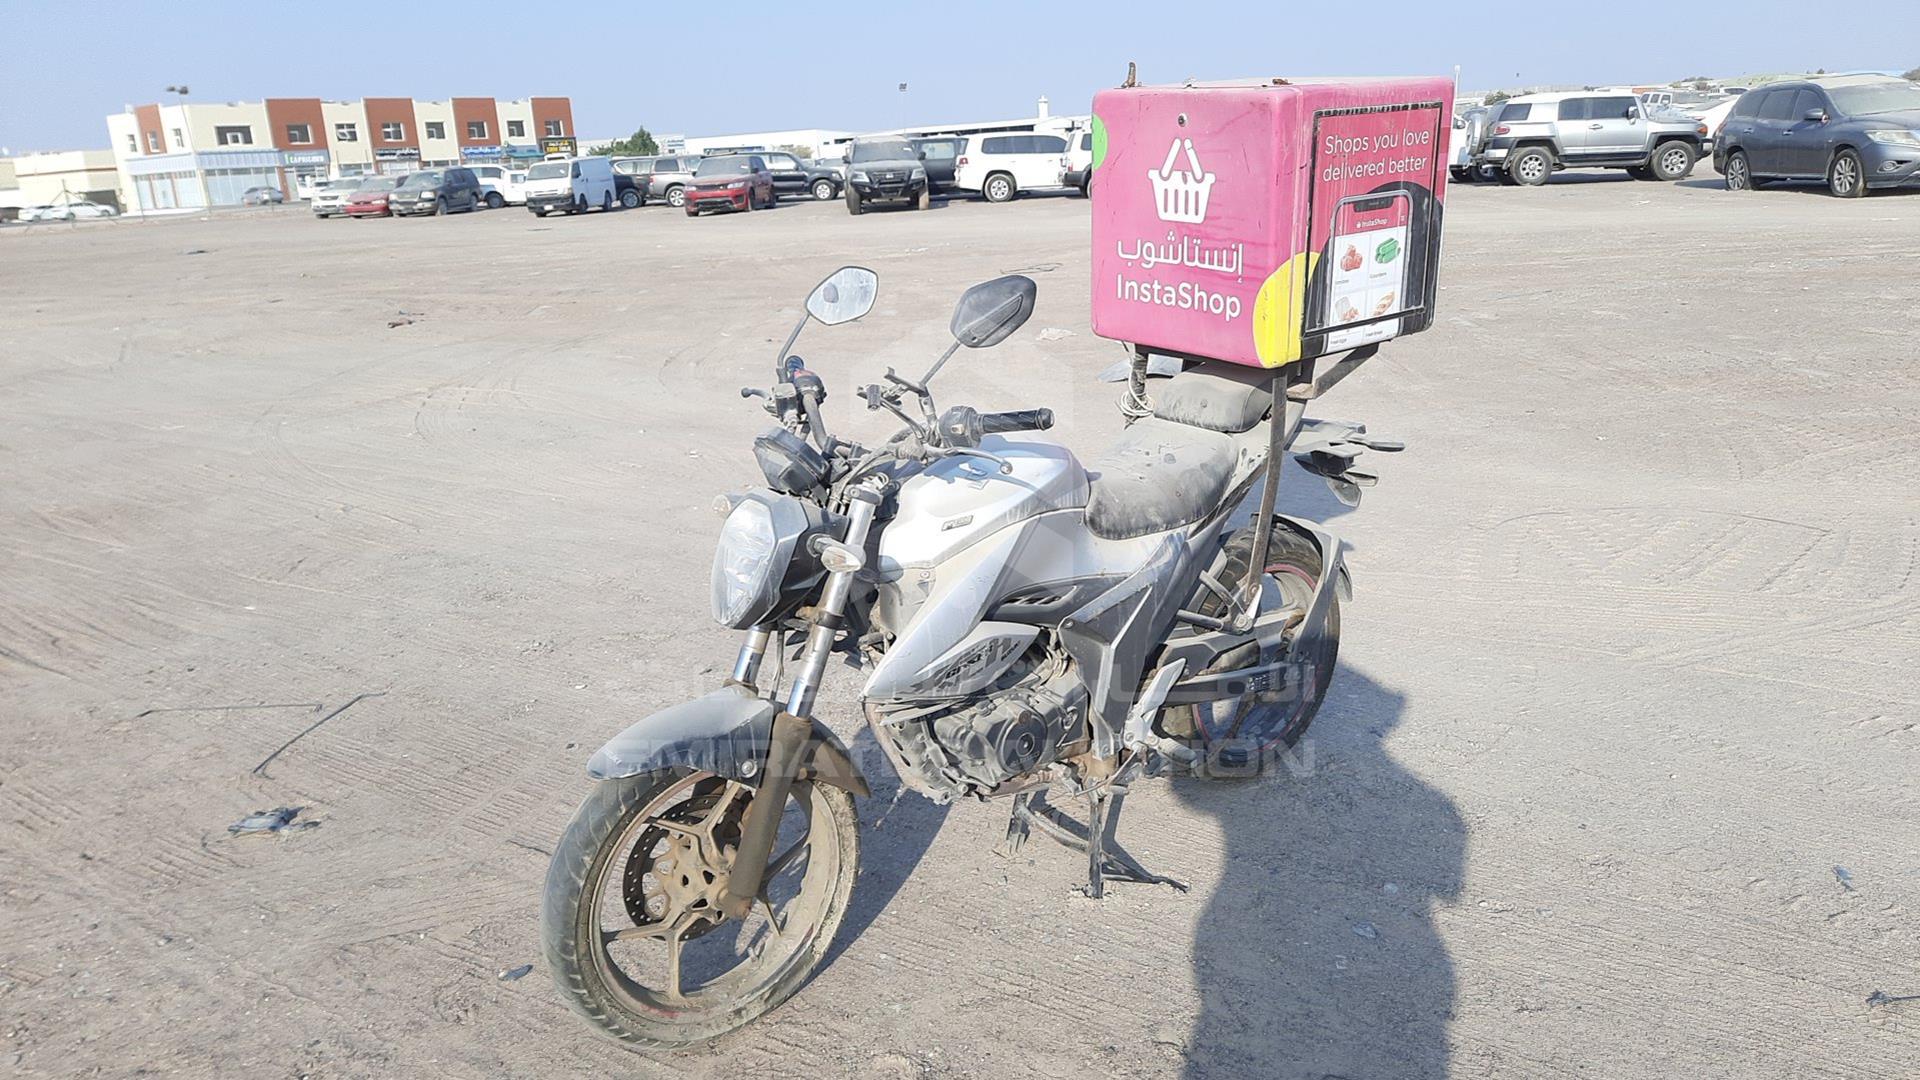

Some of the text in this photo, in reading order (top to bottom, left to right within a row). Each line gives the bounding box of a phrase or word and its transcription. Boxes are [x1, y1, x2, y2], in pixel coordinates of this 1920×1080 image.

[1325, 128, 1429, 155] Shops you love
[1323, 156, 1427, 182] delivered better
[1117, 231, 1244, 283] إنستاشوب
[1116, 274, 1242, 321] InstaShop
